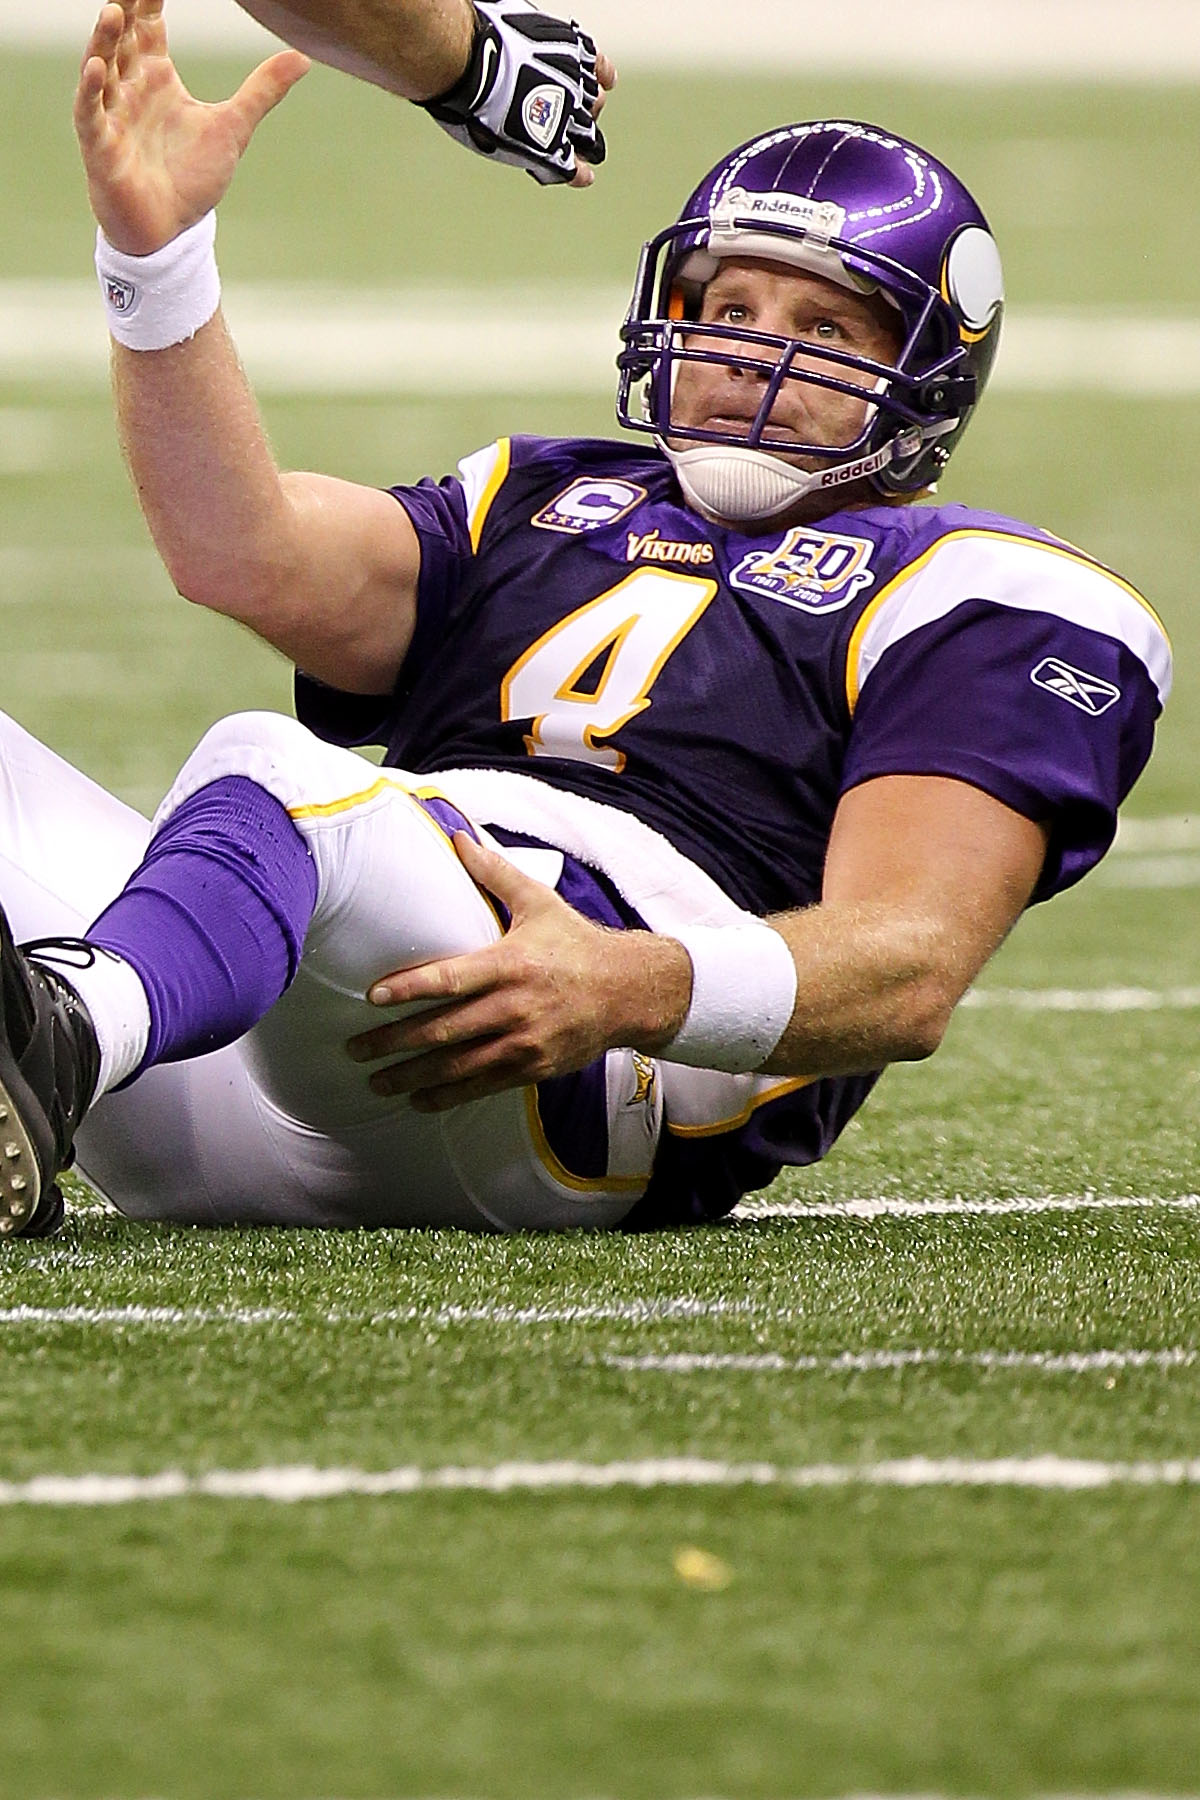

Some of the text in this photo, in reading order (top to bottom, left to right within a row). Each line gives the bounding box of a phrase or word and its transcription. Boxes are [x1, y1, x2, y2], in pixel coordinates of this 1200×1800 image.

[821, 453, 883, 486] Riddell
[554, 483, 634, 520] C
[626, 529, 715, 565] VIKINGS
[774, 537, 857, 580] 50
[501, 566, 719, 774] 4
